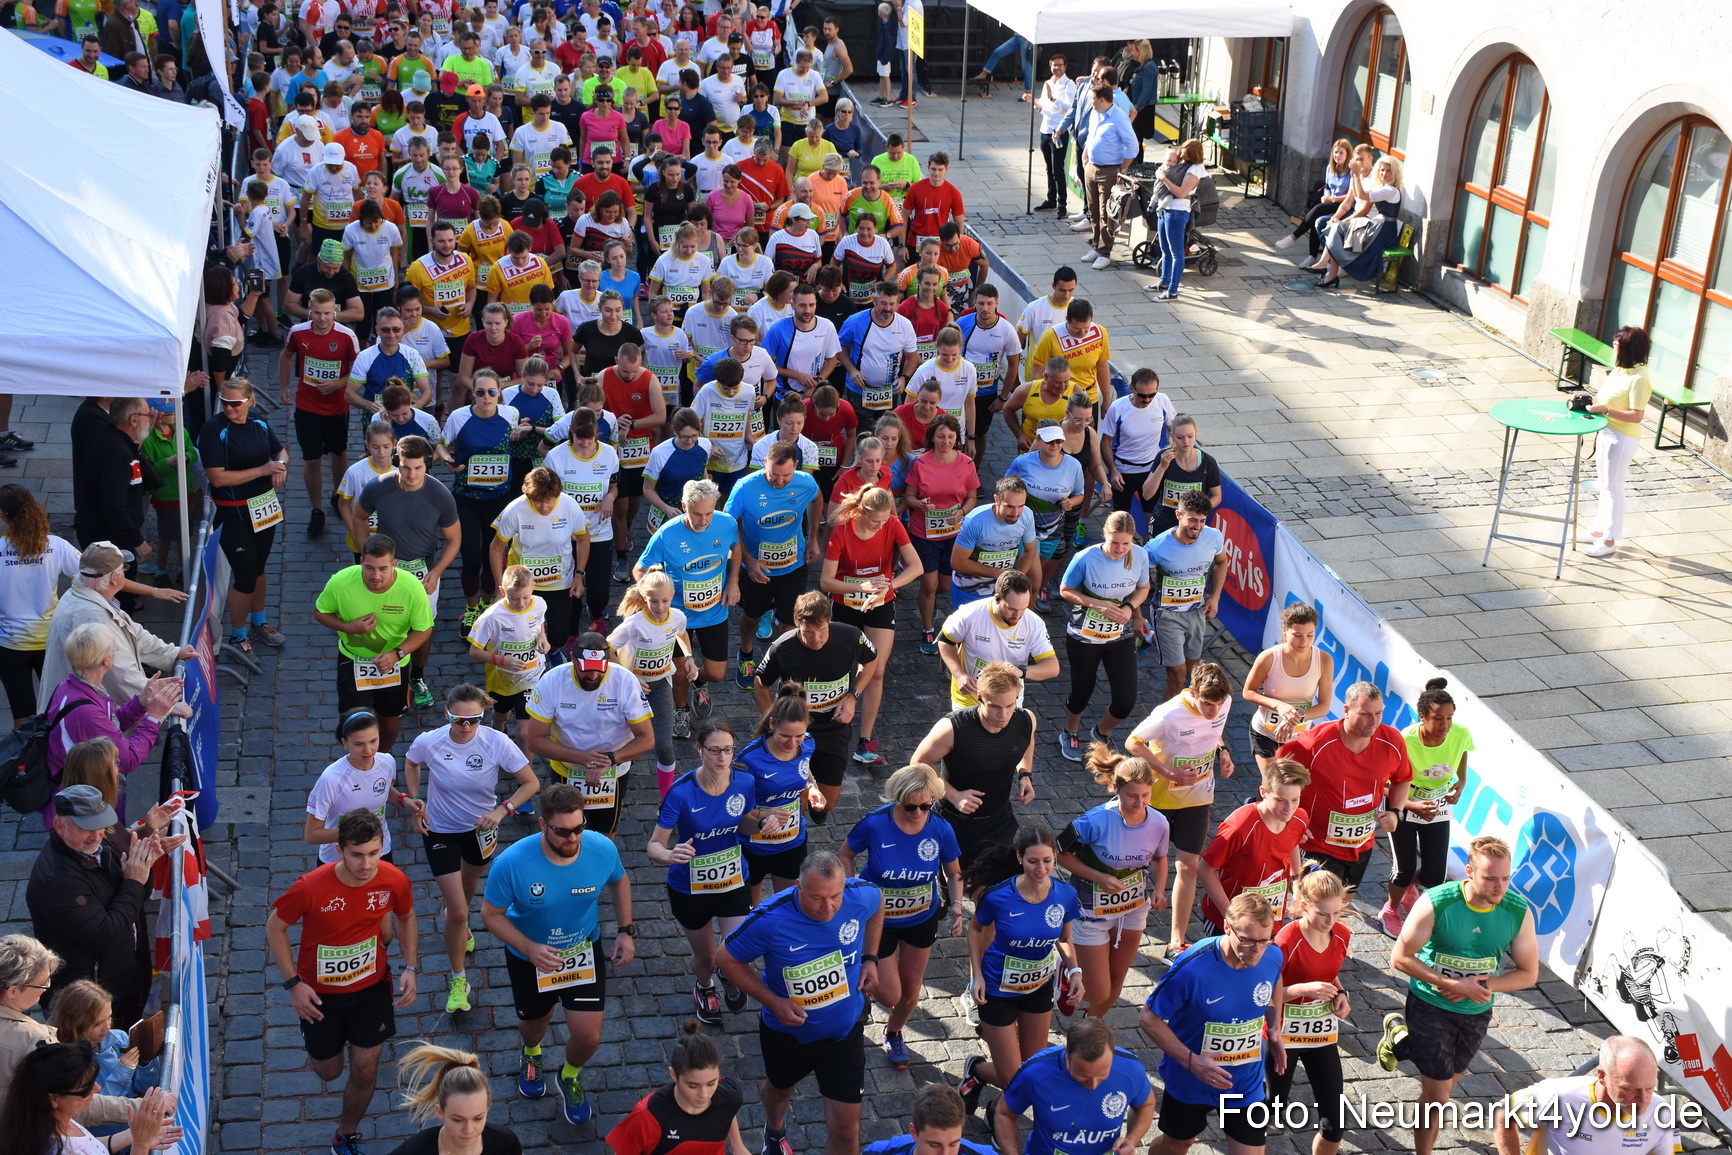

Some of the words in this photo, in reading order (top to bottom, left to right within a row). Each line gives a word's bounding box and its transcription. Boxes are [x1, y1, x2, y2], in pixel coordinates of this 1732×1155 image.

[912, 18, 920, 33] FUN
[361, 276, 384, 284] 5273
[454, 268, 470, 280] BÖGL
[508, 280, 524, 288] MAX
[526, 271, 543, 280] BÖGL
[436, 281, 462, 289] BOCK
[438, 291, 460, 299] 5101
[1063, 351, 1083, 360] MAX
[308, 368, 336, 379] 5188
[867, 392, 890, 400] 5049
[713, 423, 740, 431] 5227
[472, 455, 507, 463] BOCK
[623, 449, 647, 458] 5274
[473, 465, 503, 476] 5213
[566, 482, 599, 491] BOCK
[1026, 483, 1060, 494] RAIL.ONE
[251, 492, 275, 506] BOCK
[1168, 490, 1180, 499] 51
[255, 502, 278, 519] 5115
[258, 516, 279, 527] SUSANNE
[931, 519, 944, 528] 52
[761, 540, 795, 549] BOCK
[982, 539, 1013, 547] RAIL.ONE
[763, 549, 793, 560] 5094
[979, 551, 1014, 560] BOCK
[1215, 512, 1264, 598] Hervis
[982, 559, 1009, 569] 5135
[686, 576, 720, 589] BOCK
[1092, 581, 1126, 589] RAIL.ONE
[1167, 578, 1201, 587] BOCK
[689, 587, 718, 601] 5093
[1168, 588, 1199, 597] 5134
[693, 598, 716, 608] HELMUT
[1088, 620, 1119, 632] 5133
[505, 642, 534, 651] BOCK
[638, 645, 672, 657] BOCK
[639, 657, 670, 668] 5007
[642, 668, 665, 677] SOPHIA
[809, 677, 847, 691] BOCK
[810, 686, 844, 704] 5203
[1178, 751, 1214, 765] BOCK
[1418, 785, 1449, 800] BOCK
[1335, 810, 1376, 825] BOCK
[695, 826, 738, 840] #LÄUFT
[761, 831, 791, 840] SANDRA
[1335, 823, 1372, 839] 5185
[695, 849, 737, 865] BOCK
[1102, 852, 1143, 862] RAIL.ONE
[697, 862, 736, 881] 5073
[882, 869, 933, 881] #LÄUFT
[703, 881, 732, 890] REGINA
[1119, 874, 1138, 887] CK
[571, 886, 596, 894] BOCK
[884, 885, 929, 896] BOCK
[885, 897, 925, 909] 5071
[1100, 889, 1137, 905] 5002
[320, 904, 337, 912] Spitz
[886, 906, 924, 916] STEFANIE
[1104, 902, 1136, 915] MELANIE
[548, 932, 579, 940] Neumarkter
[323, 941, 370, 958] BOCK
[325, 953, 370, 974] 5067
[556, 953, 588, 972] 092
[787, 956, 840, 978] BOCK
[1009, 955, 1053, 970] BOCK
[1441, 954, 1494, 970] BOCK
[324, 966, 370, 983] SEBASTIAN
[552, 973, 581, 984] DANIEL
[1009, 967, 1048, 983] 5082
[793, 971, 839, 995] 5080
[1018, 983, 1038, 991] ANJA
[804, 991, 834, 1005] HORST
[1290, 1002, 1331, 1018] BOCK
[1212, 1019, 1258, 1035] BOCK
[1289, 1019, 1331, 1034] 5183
[1211, 1035, 1255, 1052] 5075
[1290, 1034, 1329, 1043] KATHRIN
[1053, 1127, 1120, 1144] #LÄUFT
